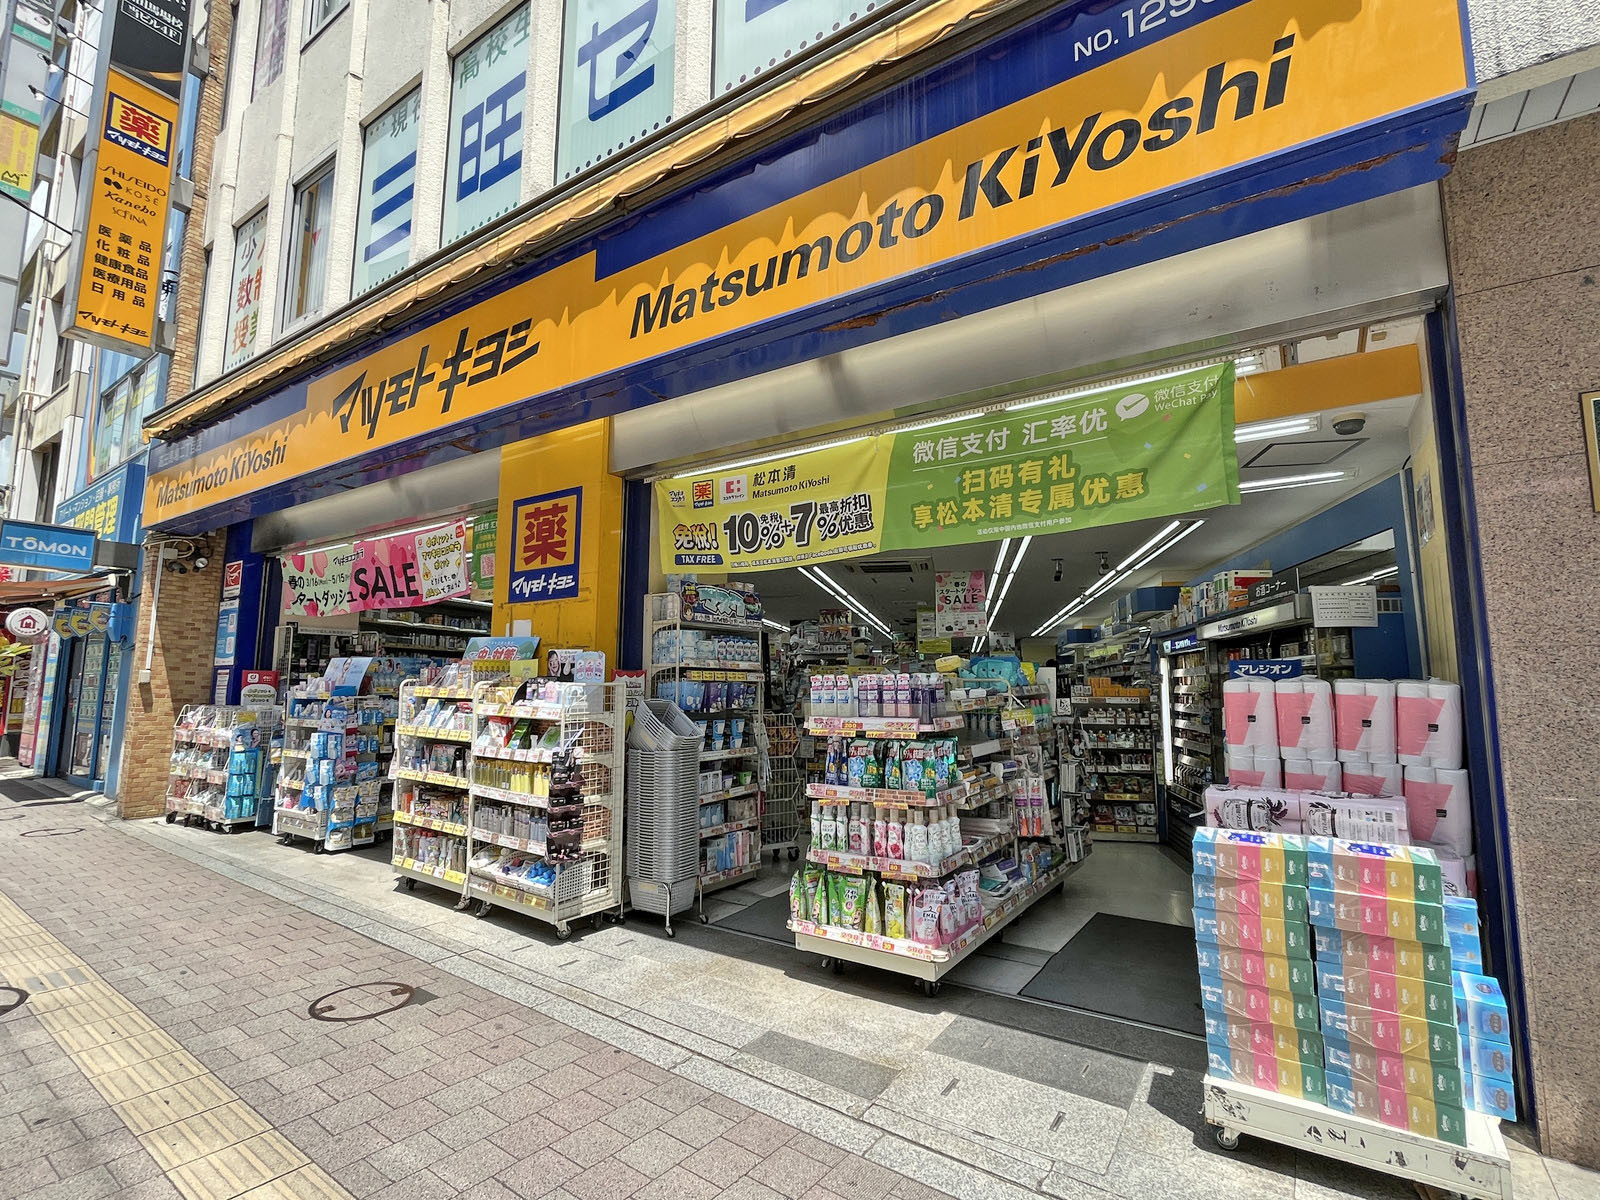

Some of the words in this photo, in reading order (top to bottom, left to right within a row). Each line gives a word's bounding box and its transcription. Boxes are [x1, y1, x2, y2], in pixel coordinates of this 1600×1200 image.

[459, 8, 530, 90] 高校生
[119, 103, 160, 147] 薬
[107, 130, 168, 163] マツモトキヨシ
[98, 165, 167, 198] SHISEIDO
[629, 193, 945, 339] Matsumoto
[958, 33, 1296, 221] KiYoshi
[104, 190, 157, 217] Kanebo
[96, 238, 150, 267] 化粧品
[92, 267, 147, 294] 医療用品
[94, 253, 148, 281] 健康食品
[91, 281, 145, 308] 日用品
[78, 310, 149, 338] マツモトキヨシ
[332, 318, 540, 441] マツモトキヨシ
[1153, 374, 1220, 402] 微信支付
[1154, 396, 1197, 412] WeChat
[912, 427, 1010, 465] 微信支付
[1022, 406, 1108, 445] 汇率优
[156, 467, 228, 509] Matsumoto
[230, 436, 289, 483] KiYoshi
[752, 464, 797, 488] 松本清
[962, 453, 1076, 496] 扫码有礼
[752, 484, 798, 499] Matsumoto
[799, 475, 831, 491] KiYoshi
[912, 470, 1145, 530] 享松本清专属优惠
[523, 503, 569, 566] 薬
[681, 555, 696, 564] TAX
[696, 553, 717, 564] FREE
[354, 563, 420, 601] SALE
[512, 572, 576, 598] マツモトキヨシ
[1255, 580, 1287, 598] お酒コーナー
[944, 594, 979, 605] SALE
[1238, 664, 1292, 675] アレジオン
